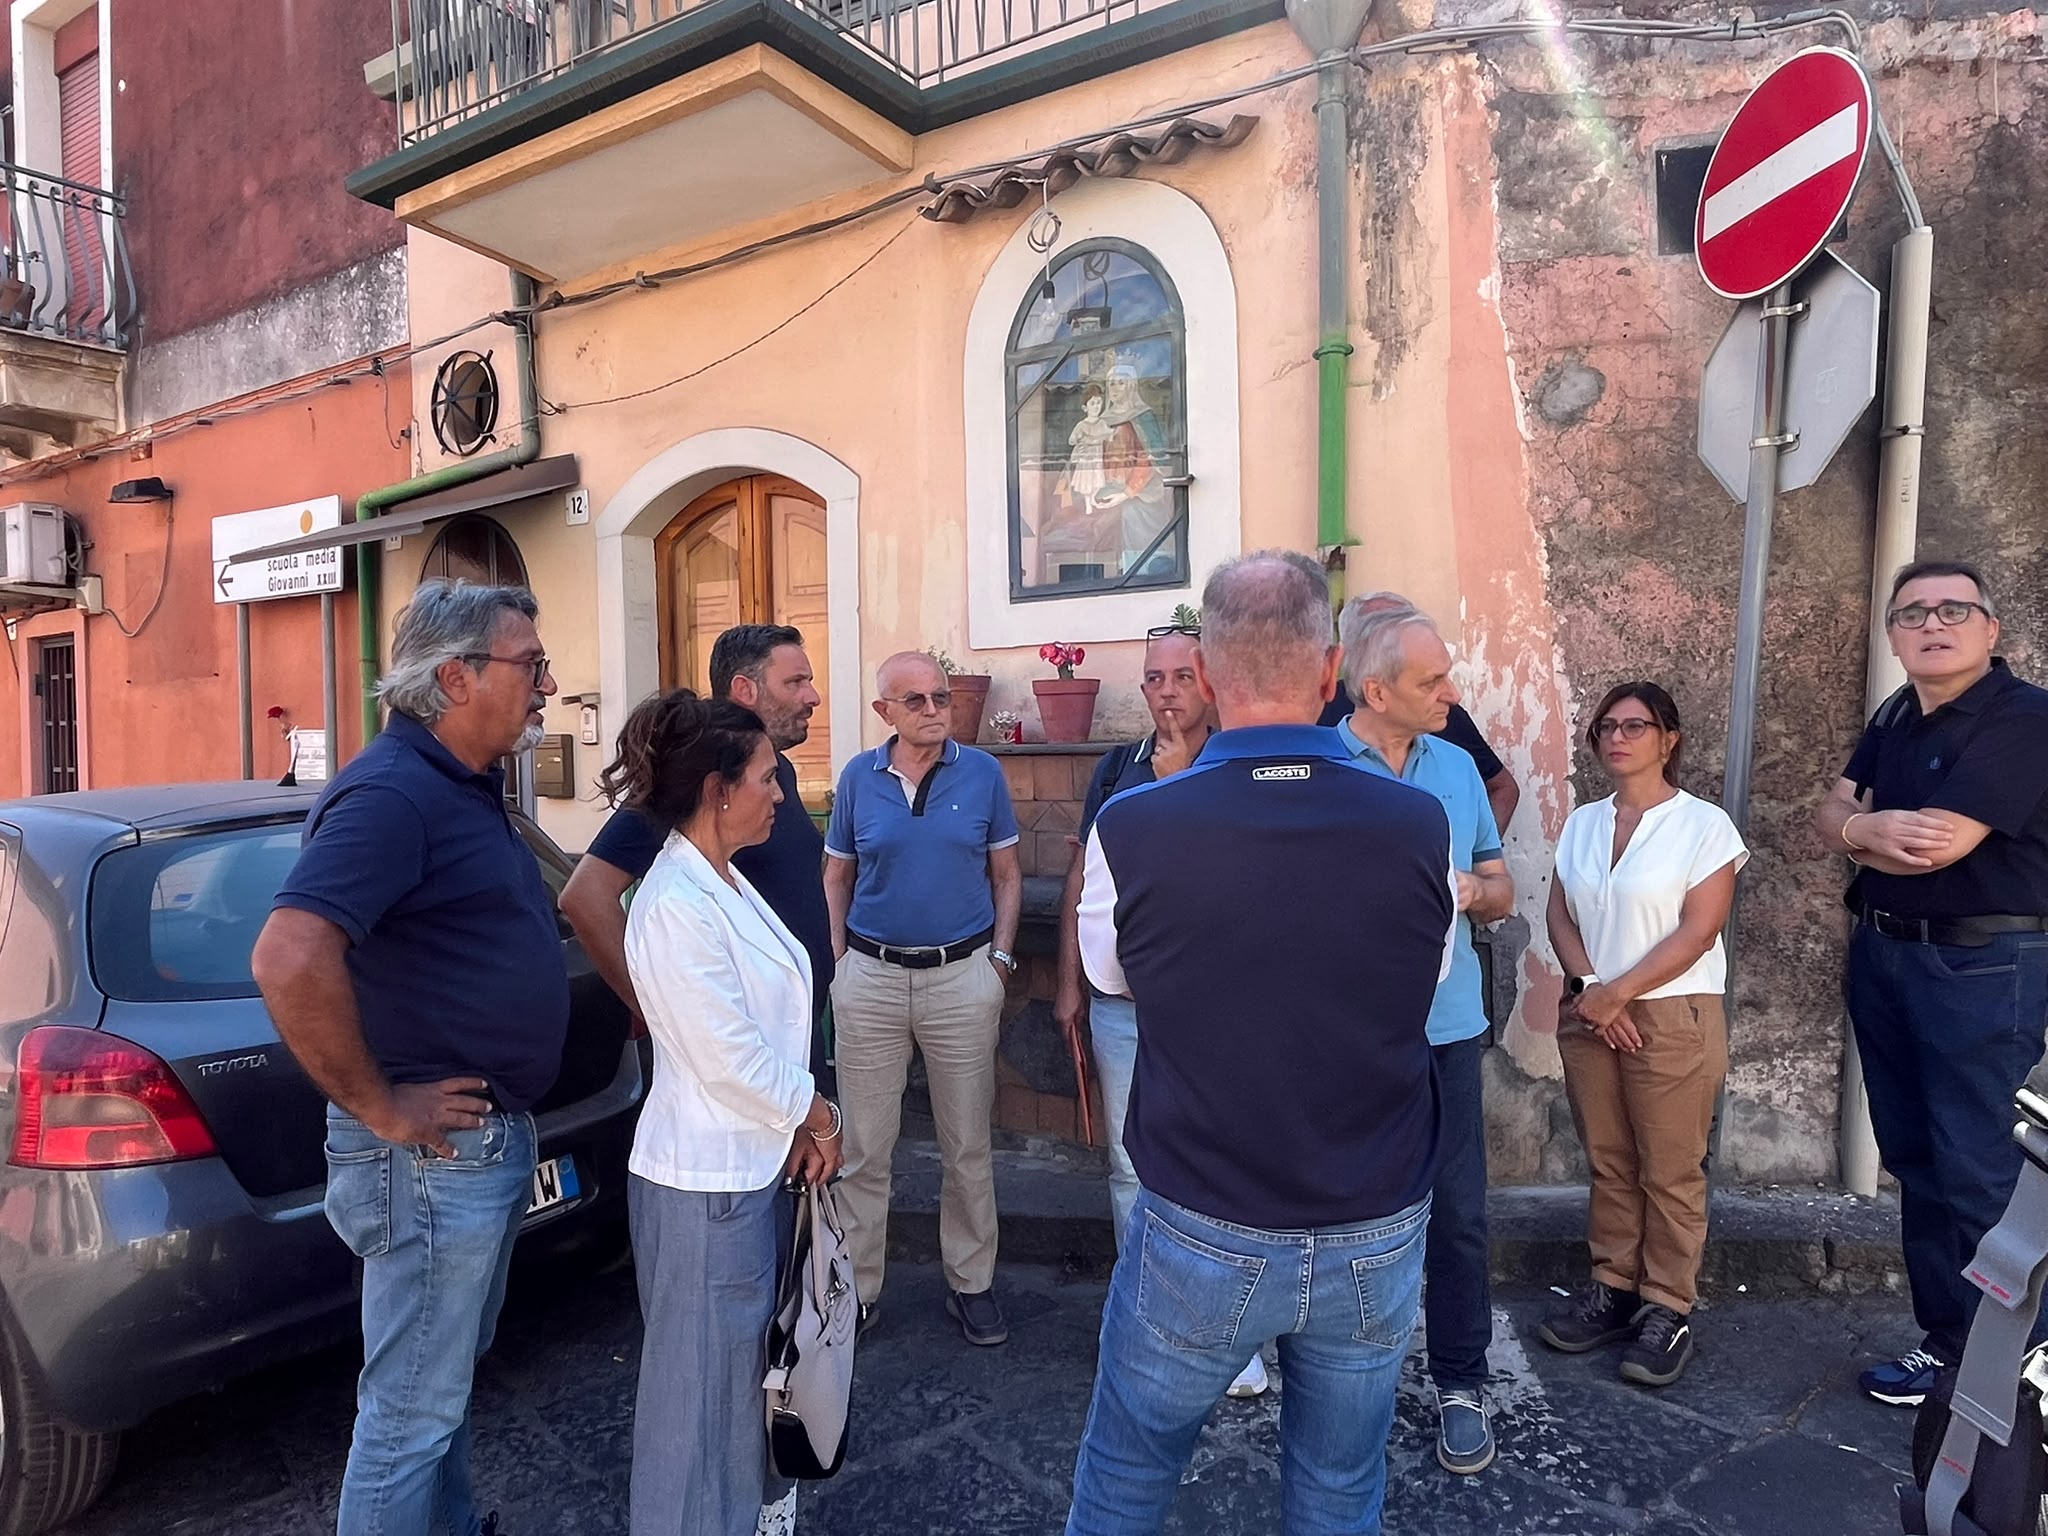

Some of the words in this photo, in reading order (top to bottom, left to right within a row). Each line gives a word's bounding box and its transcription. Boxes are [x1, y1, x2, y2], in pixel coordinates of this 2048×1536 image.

[1901, 475, 1912, 502] ENEL
[571, 496, 583, 515] 12
[267, 555, 298, 572] scuola
[306, 548, 336, 566] media
[268, 572, 309, 592] Giovanni
[317, 572, 337, 586] XXIII
[1256, 768, 1307, 778] LACOSTE
[197, 1054, 269, 1077] TOYOTA
